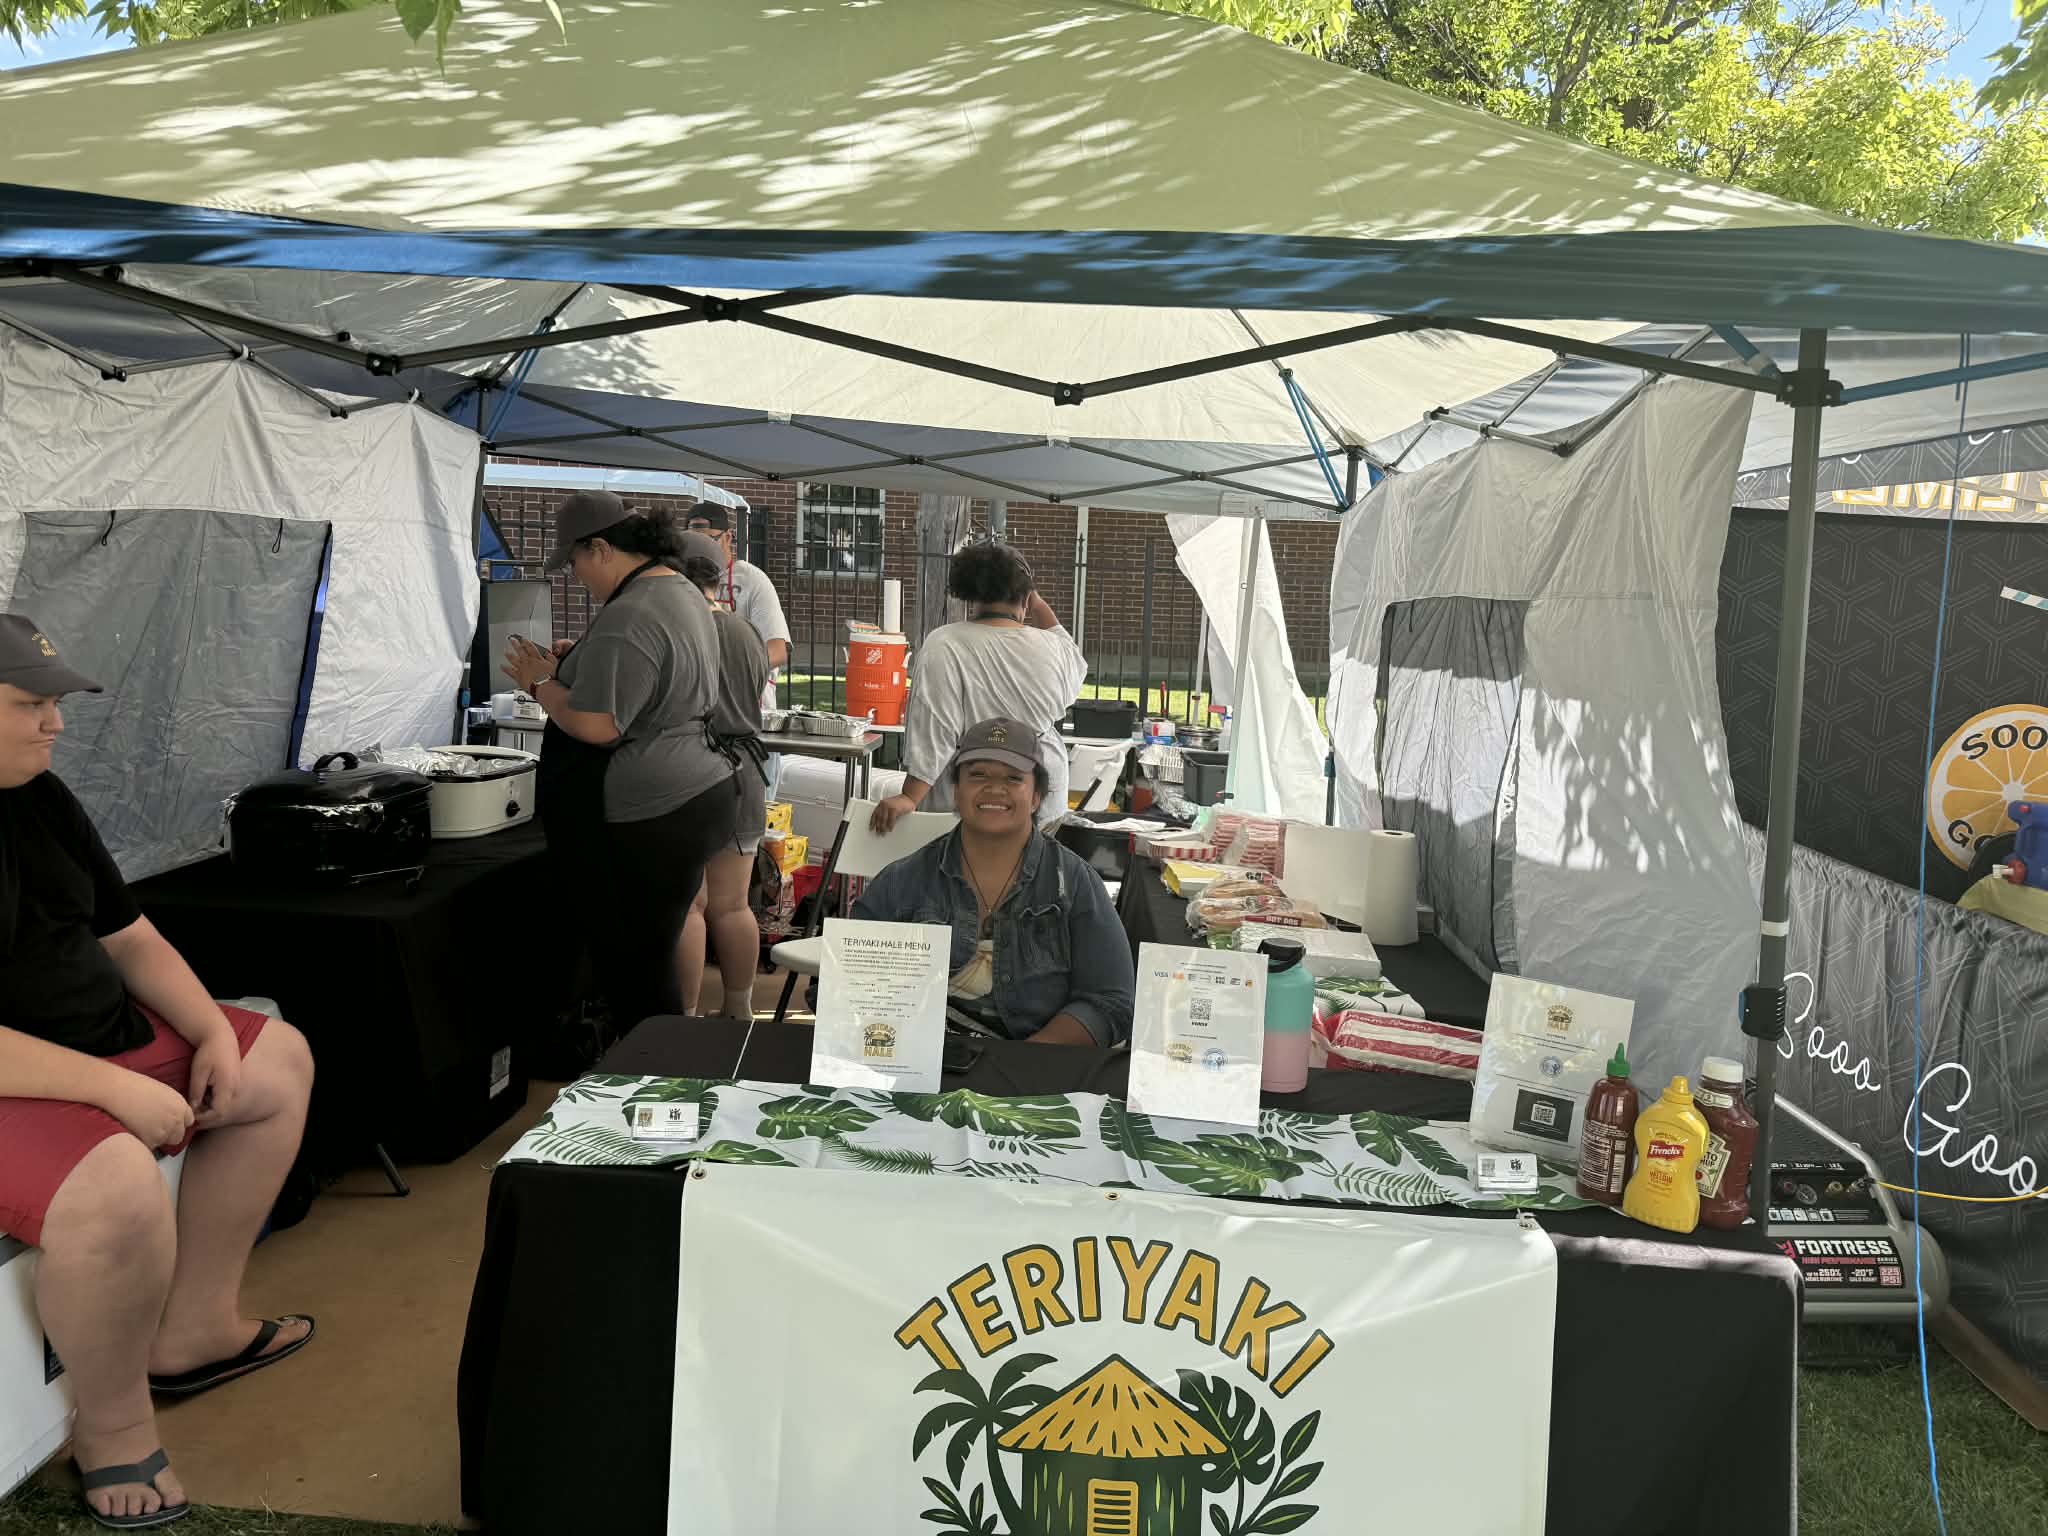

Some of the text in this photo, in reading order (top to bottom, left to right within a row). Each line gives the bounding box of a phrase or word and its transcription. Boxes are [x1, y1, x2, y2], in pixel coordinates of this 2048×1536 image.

[842, 937, 931, 951] TERIYAKI HALE MENU
[1650, 1146, 1681, 1157] French's
[1794, 1240, 1893, 1255] FORTRESS
[894, 1236, 1335, 1399] TERIYAKI
